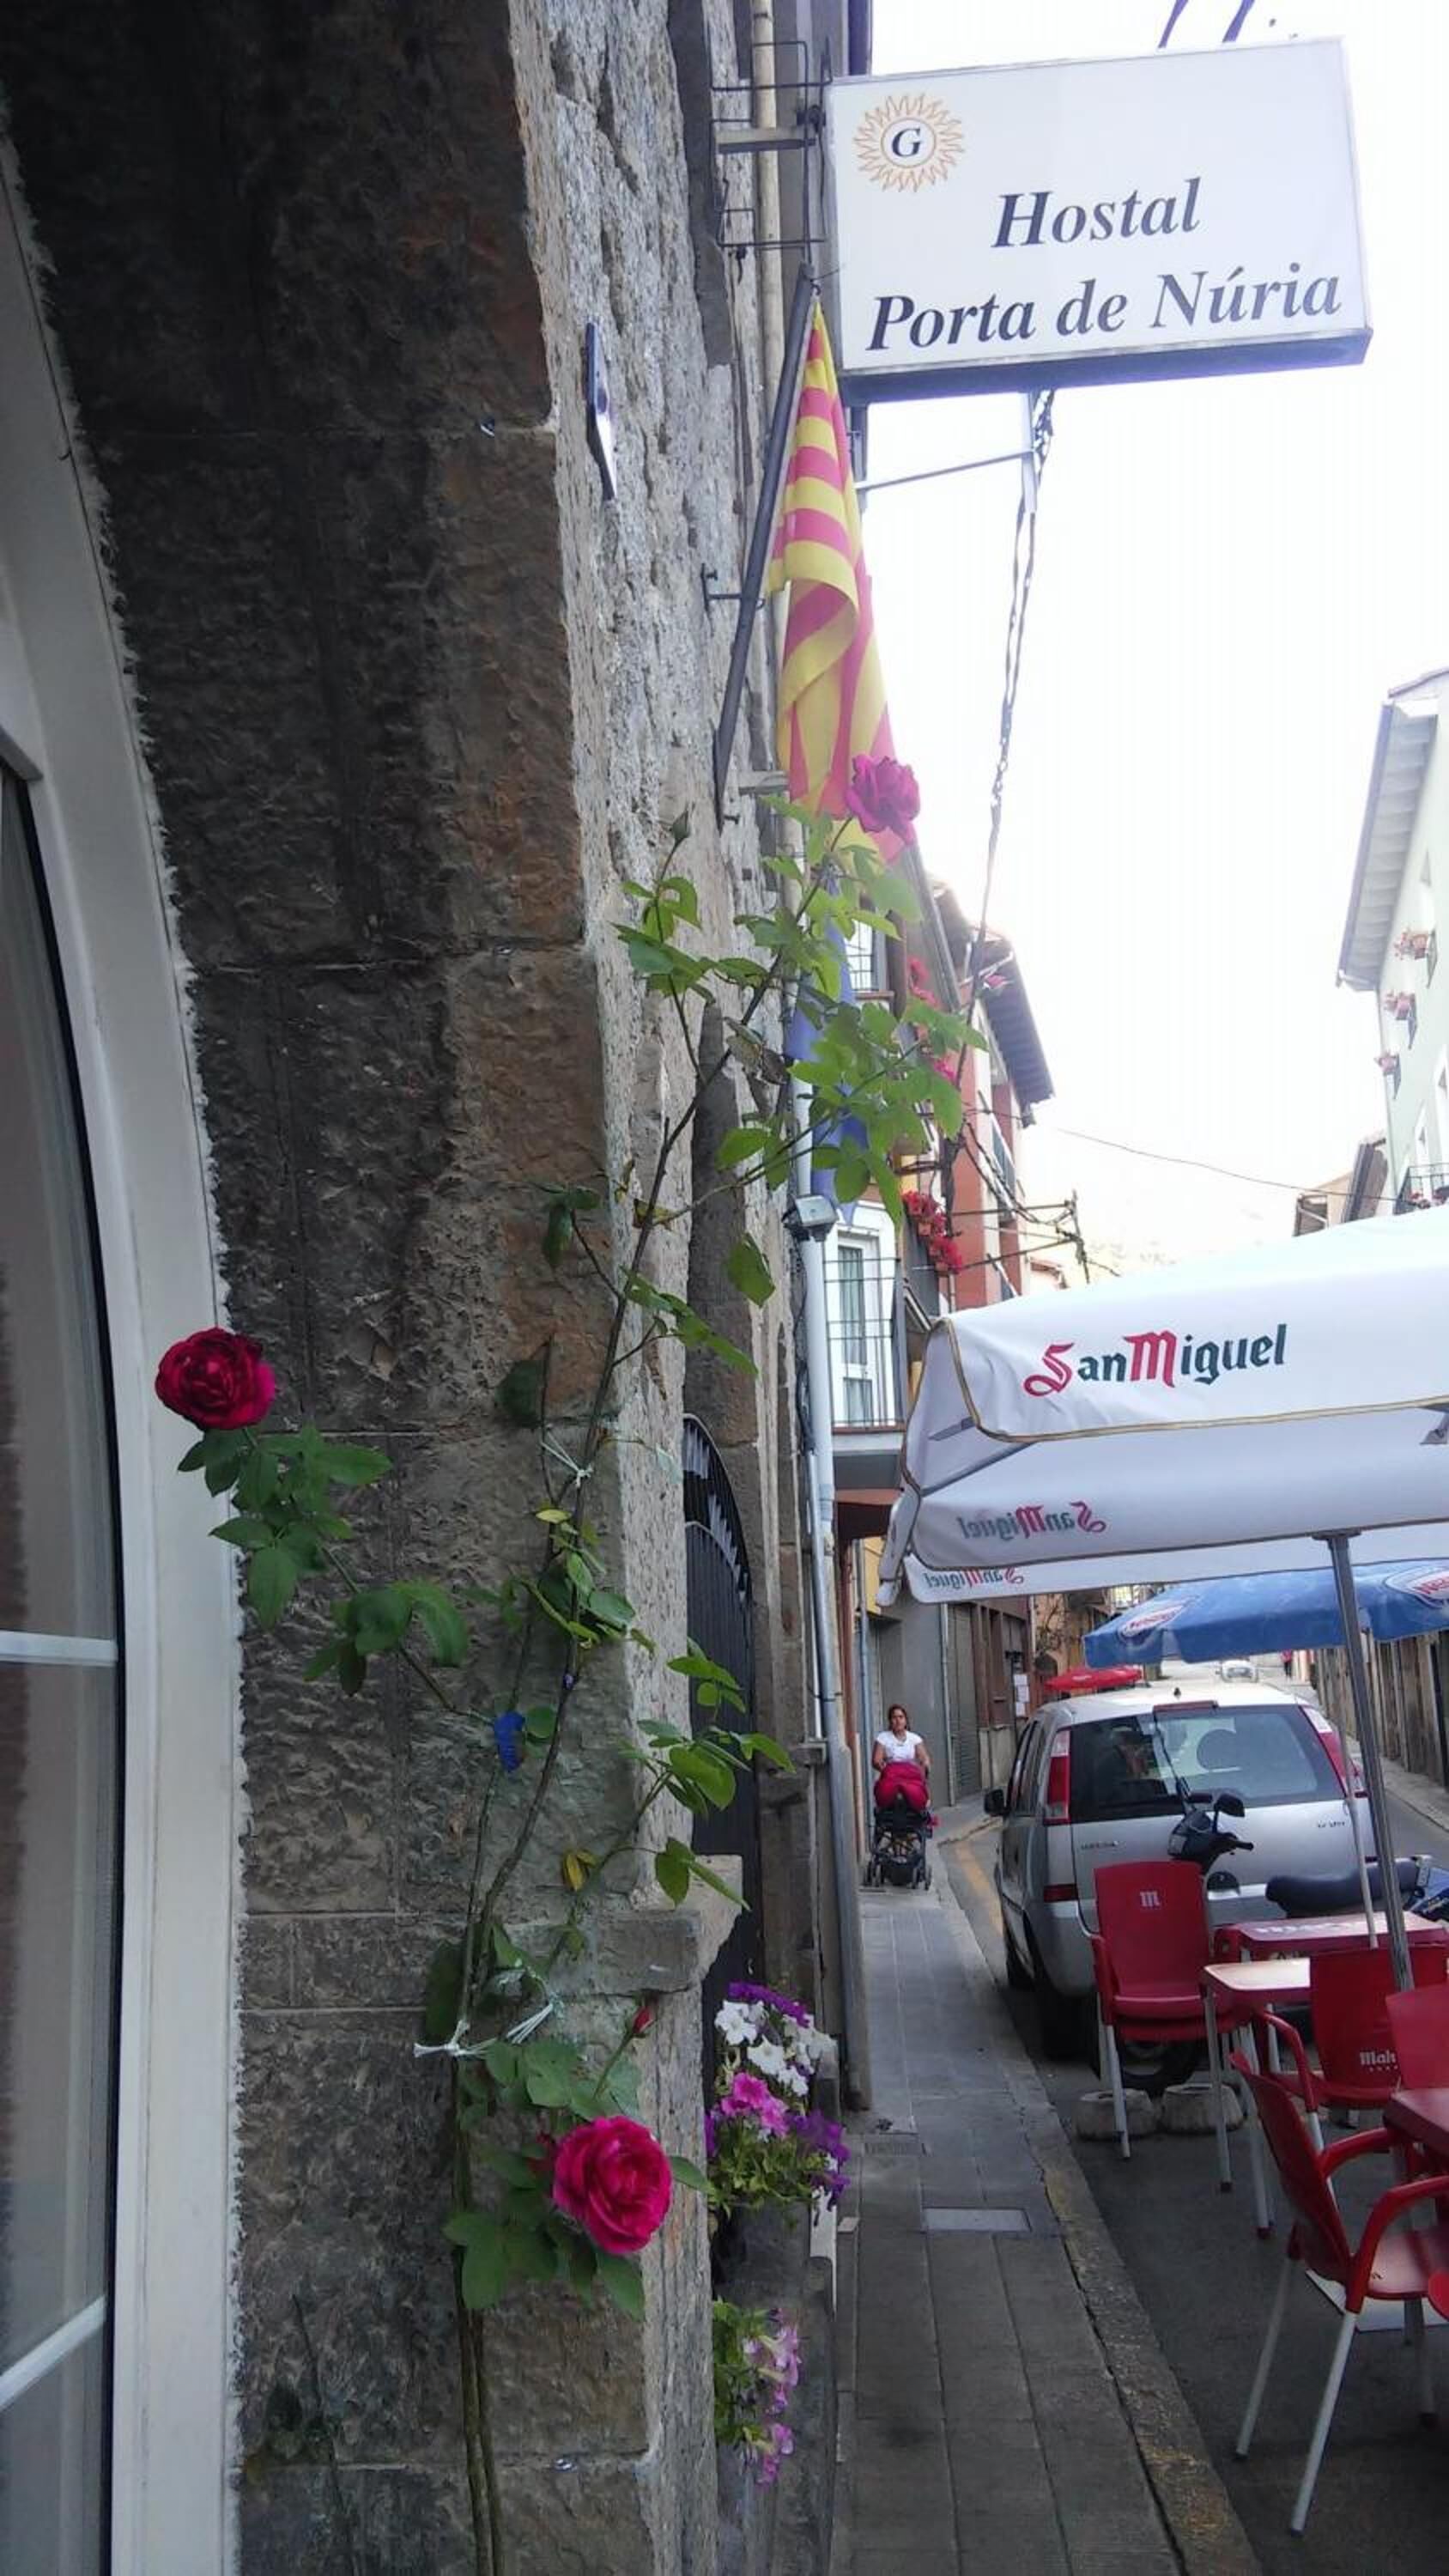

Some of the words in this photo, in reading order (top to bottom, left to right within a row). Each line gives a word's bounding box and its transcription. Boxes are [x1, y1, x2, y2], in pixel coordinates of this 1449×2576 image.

[891, 126, 921, 157] G
[990, 175, 1201, 248] Hostal
[864, 293, 1036, 351] Porta
[1056, 278, 1128, 336] de
[1149, 262, 1343, 328] Núria
